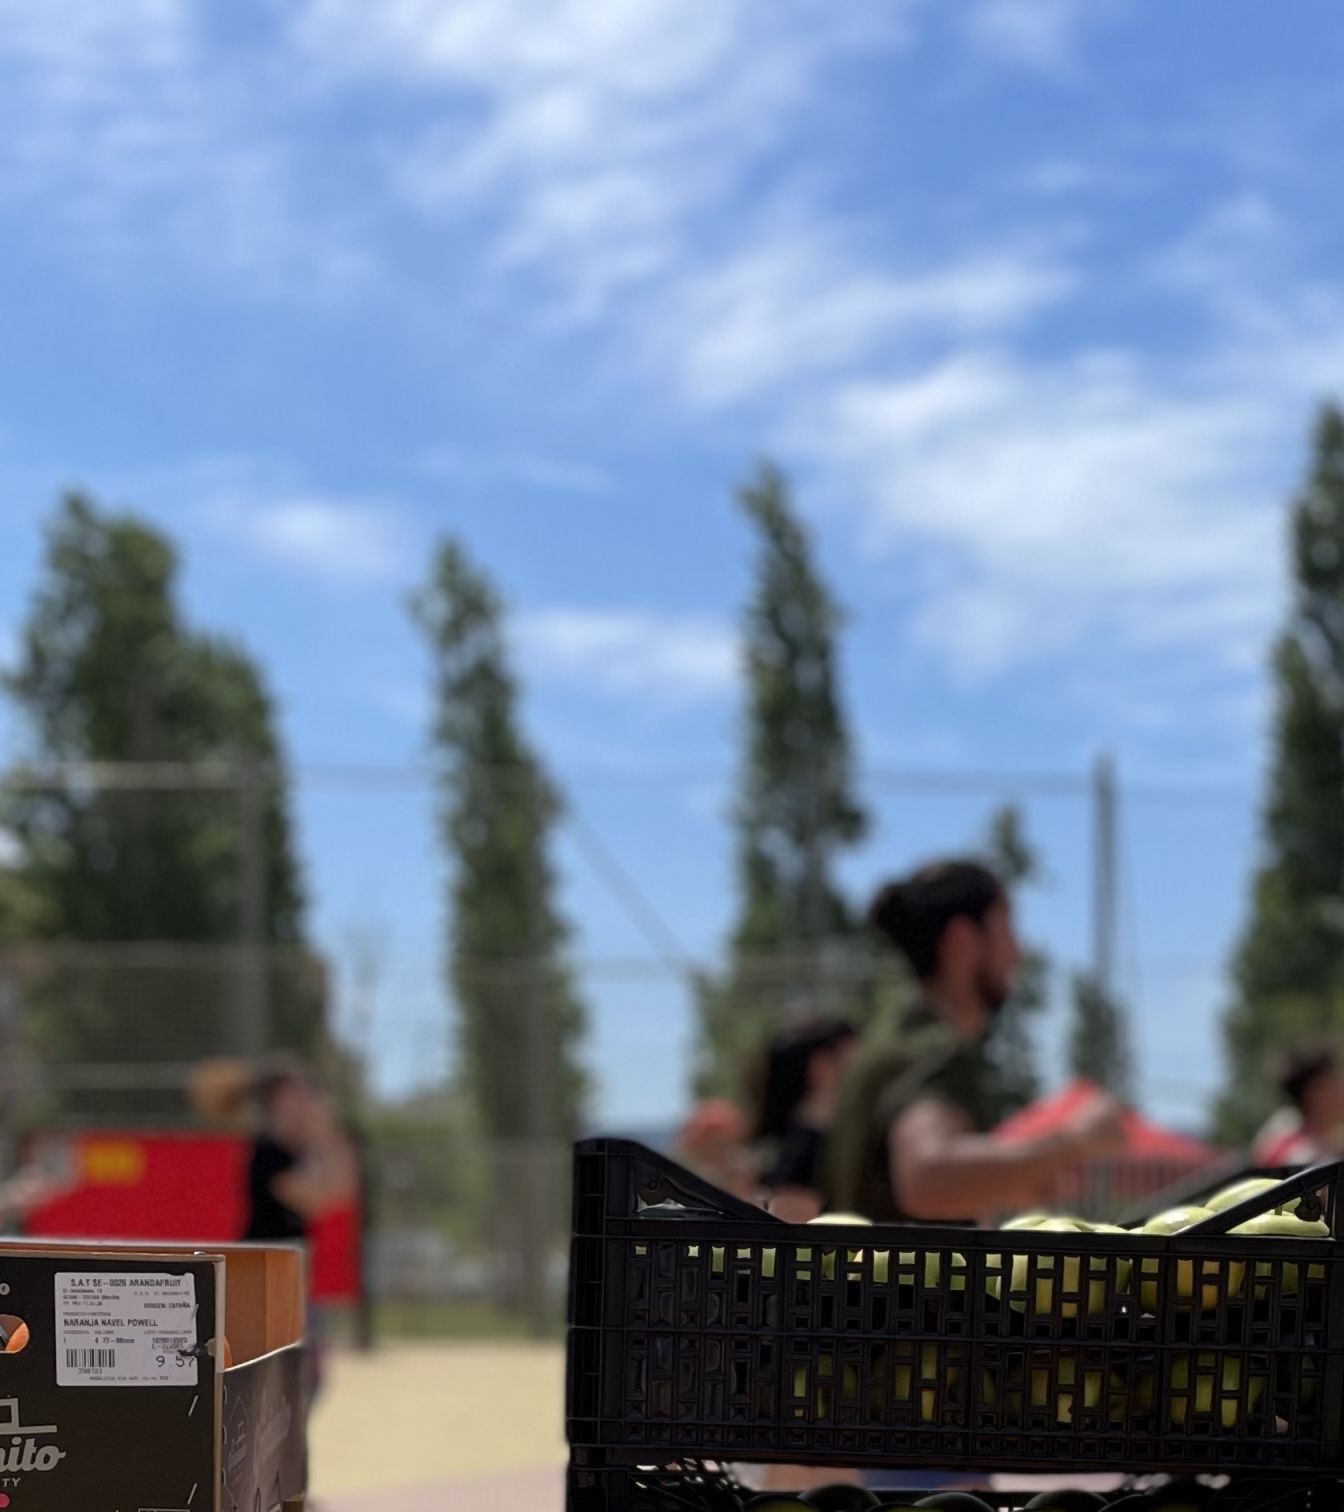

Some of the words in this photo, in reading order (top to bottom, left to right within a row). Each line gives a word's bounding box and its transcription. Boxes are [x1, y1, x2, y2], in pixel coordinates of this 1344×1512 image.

[128, 1278, 182, 1287] ARANDAFRUIT
[63, 1318, 99, 1327] NARANJA
[101, 1318, 125, 1327] NAVEL
[127, 1318, 158, 1327] POWELL
